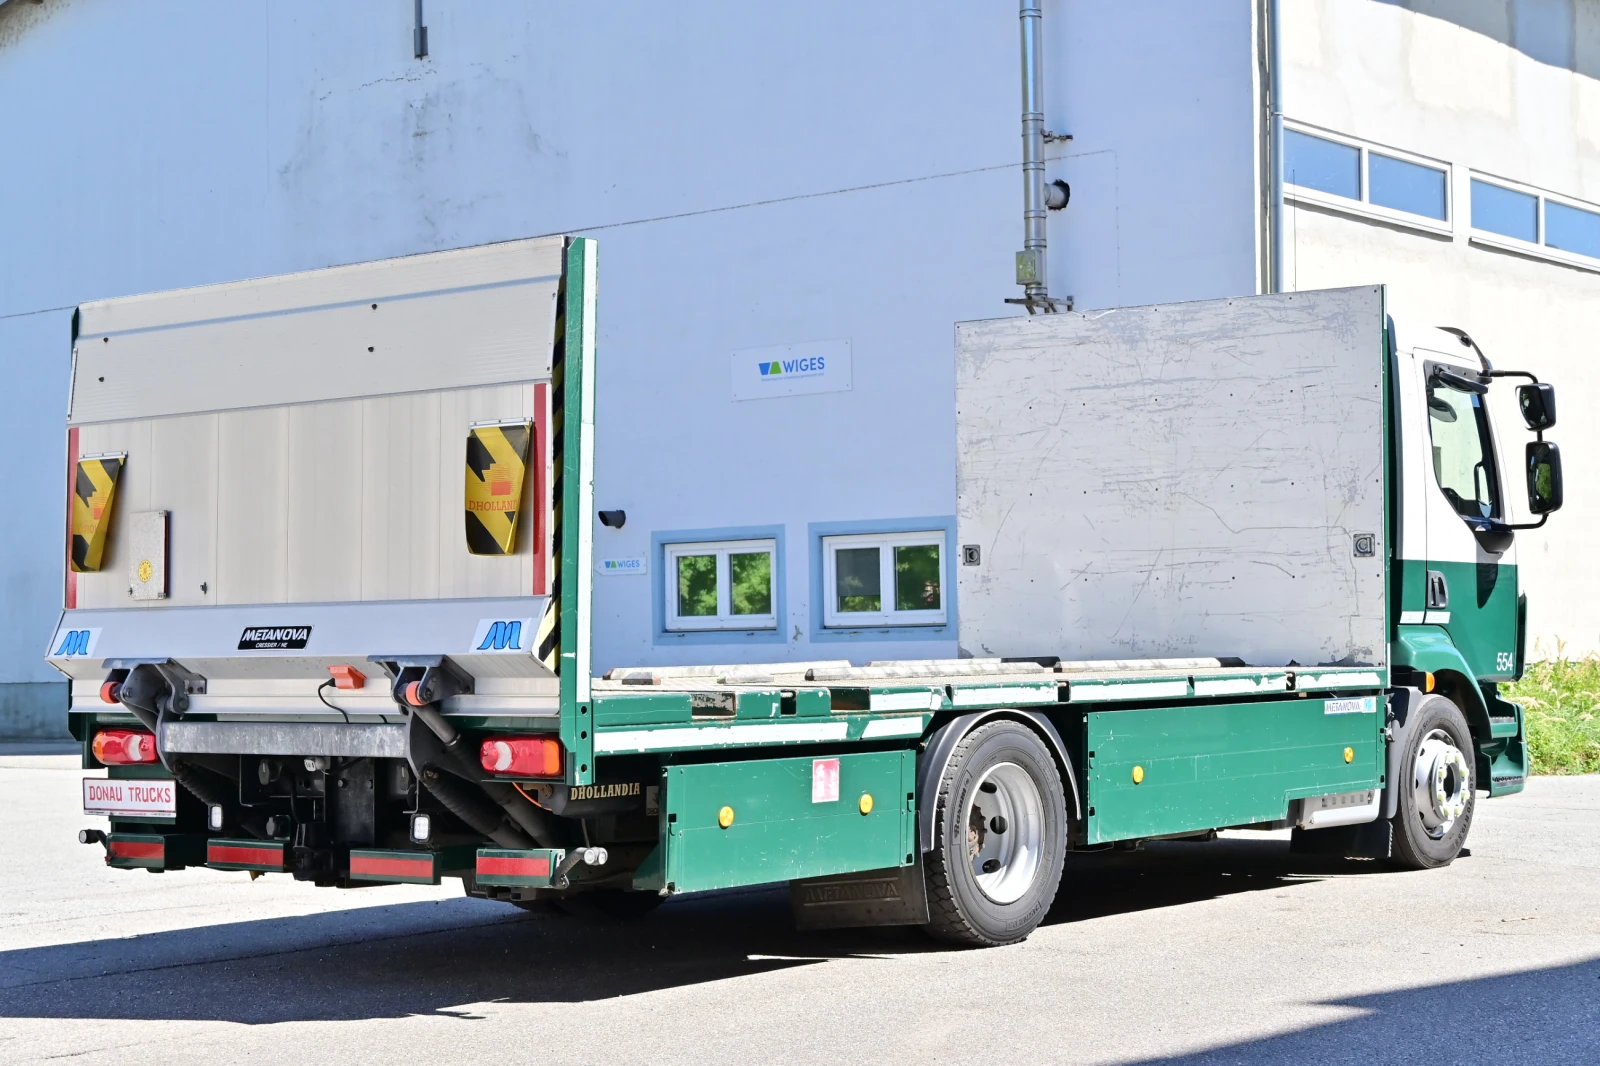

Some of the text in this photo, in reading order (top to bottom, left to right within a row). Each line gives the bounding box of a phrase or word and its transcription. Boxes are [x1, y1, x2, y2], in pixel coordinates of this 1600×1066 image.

[782, 356, 825, 373] WIGES
[617, 559, 641, 569] WIGES
[241, 628, 308, 641] METANOVA
[1496, 651, 1513, 671] 554
[1325, 701, 1361, 712] METANOVA
[89, 785, 171, 803] DONAU TRUCKS
[570, 782, 640, 801] DHOLLANDIA
